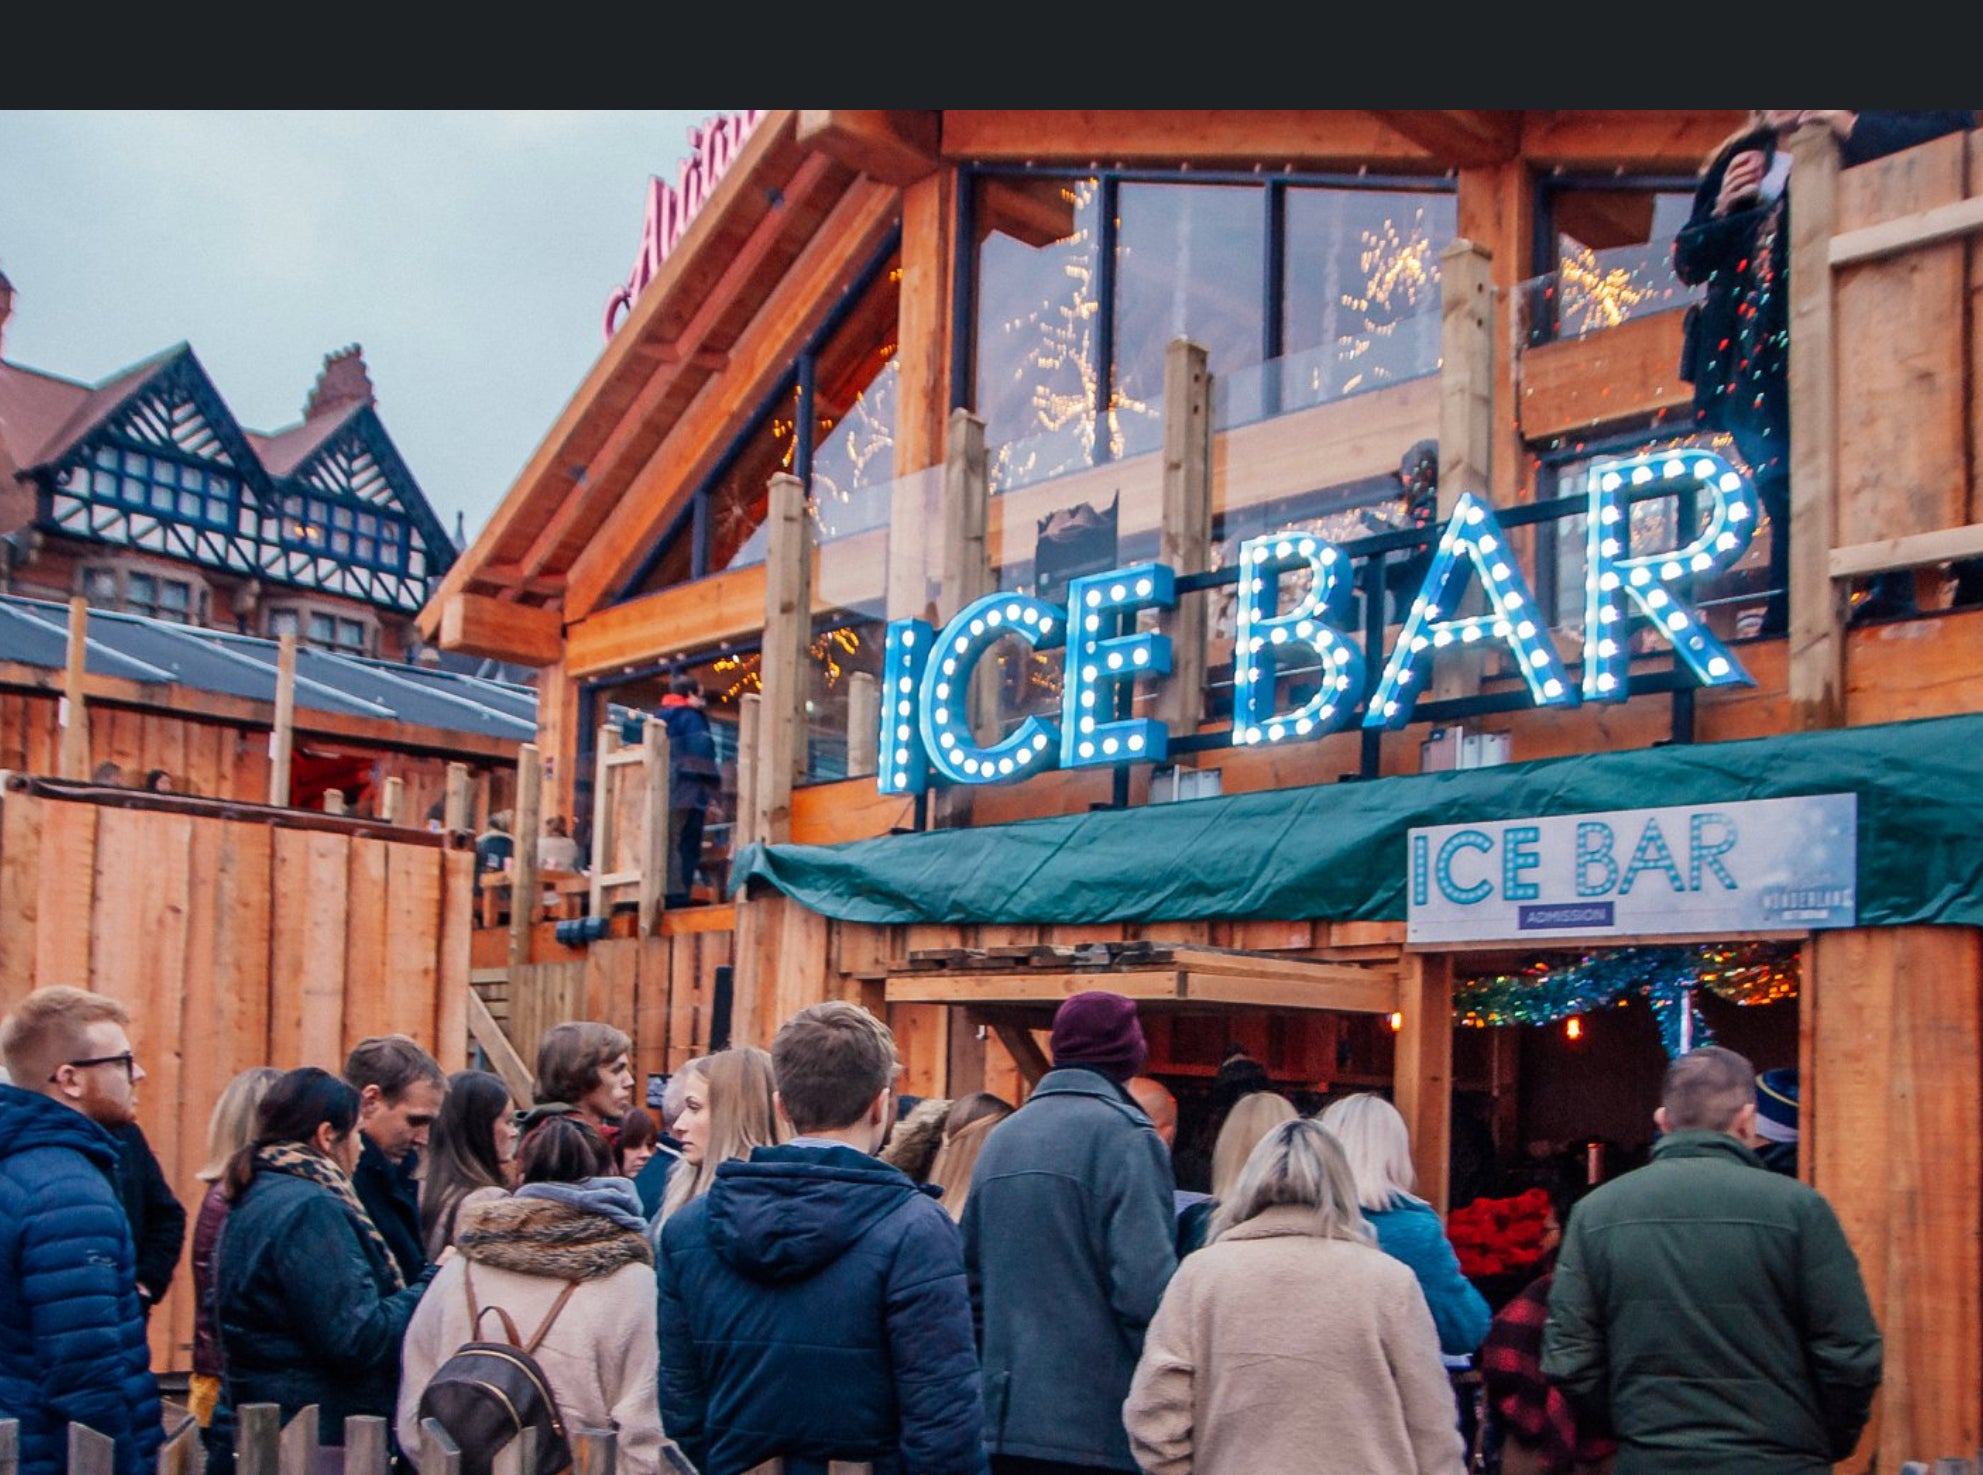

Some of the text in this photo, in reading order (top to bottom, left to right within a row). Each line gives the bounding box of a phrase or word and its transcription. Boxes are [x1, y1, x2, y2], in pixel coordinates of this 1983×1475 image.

[878, 448, 1760, 796] ICE BAR
[1413, 812, 1739, 907] ICE BAR
